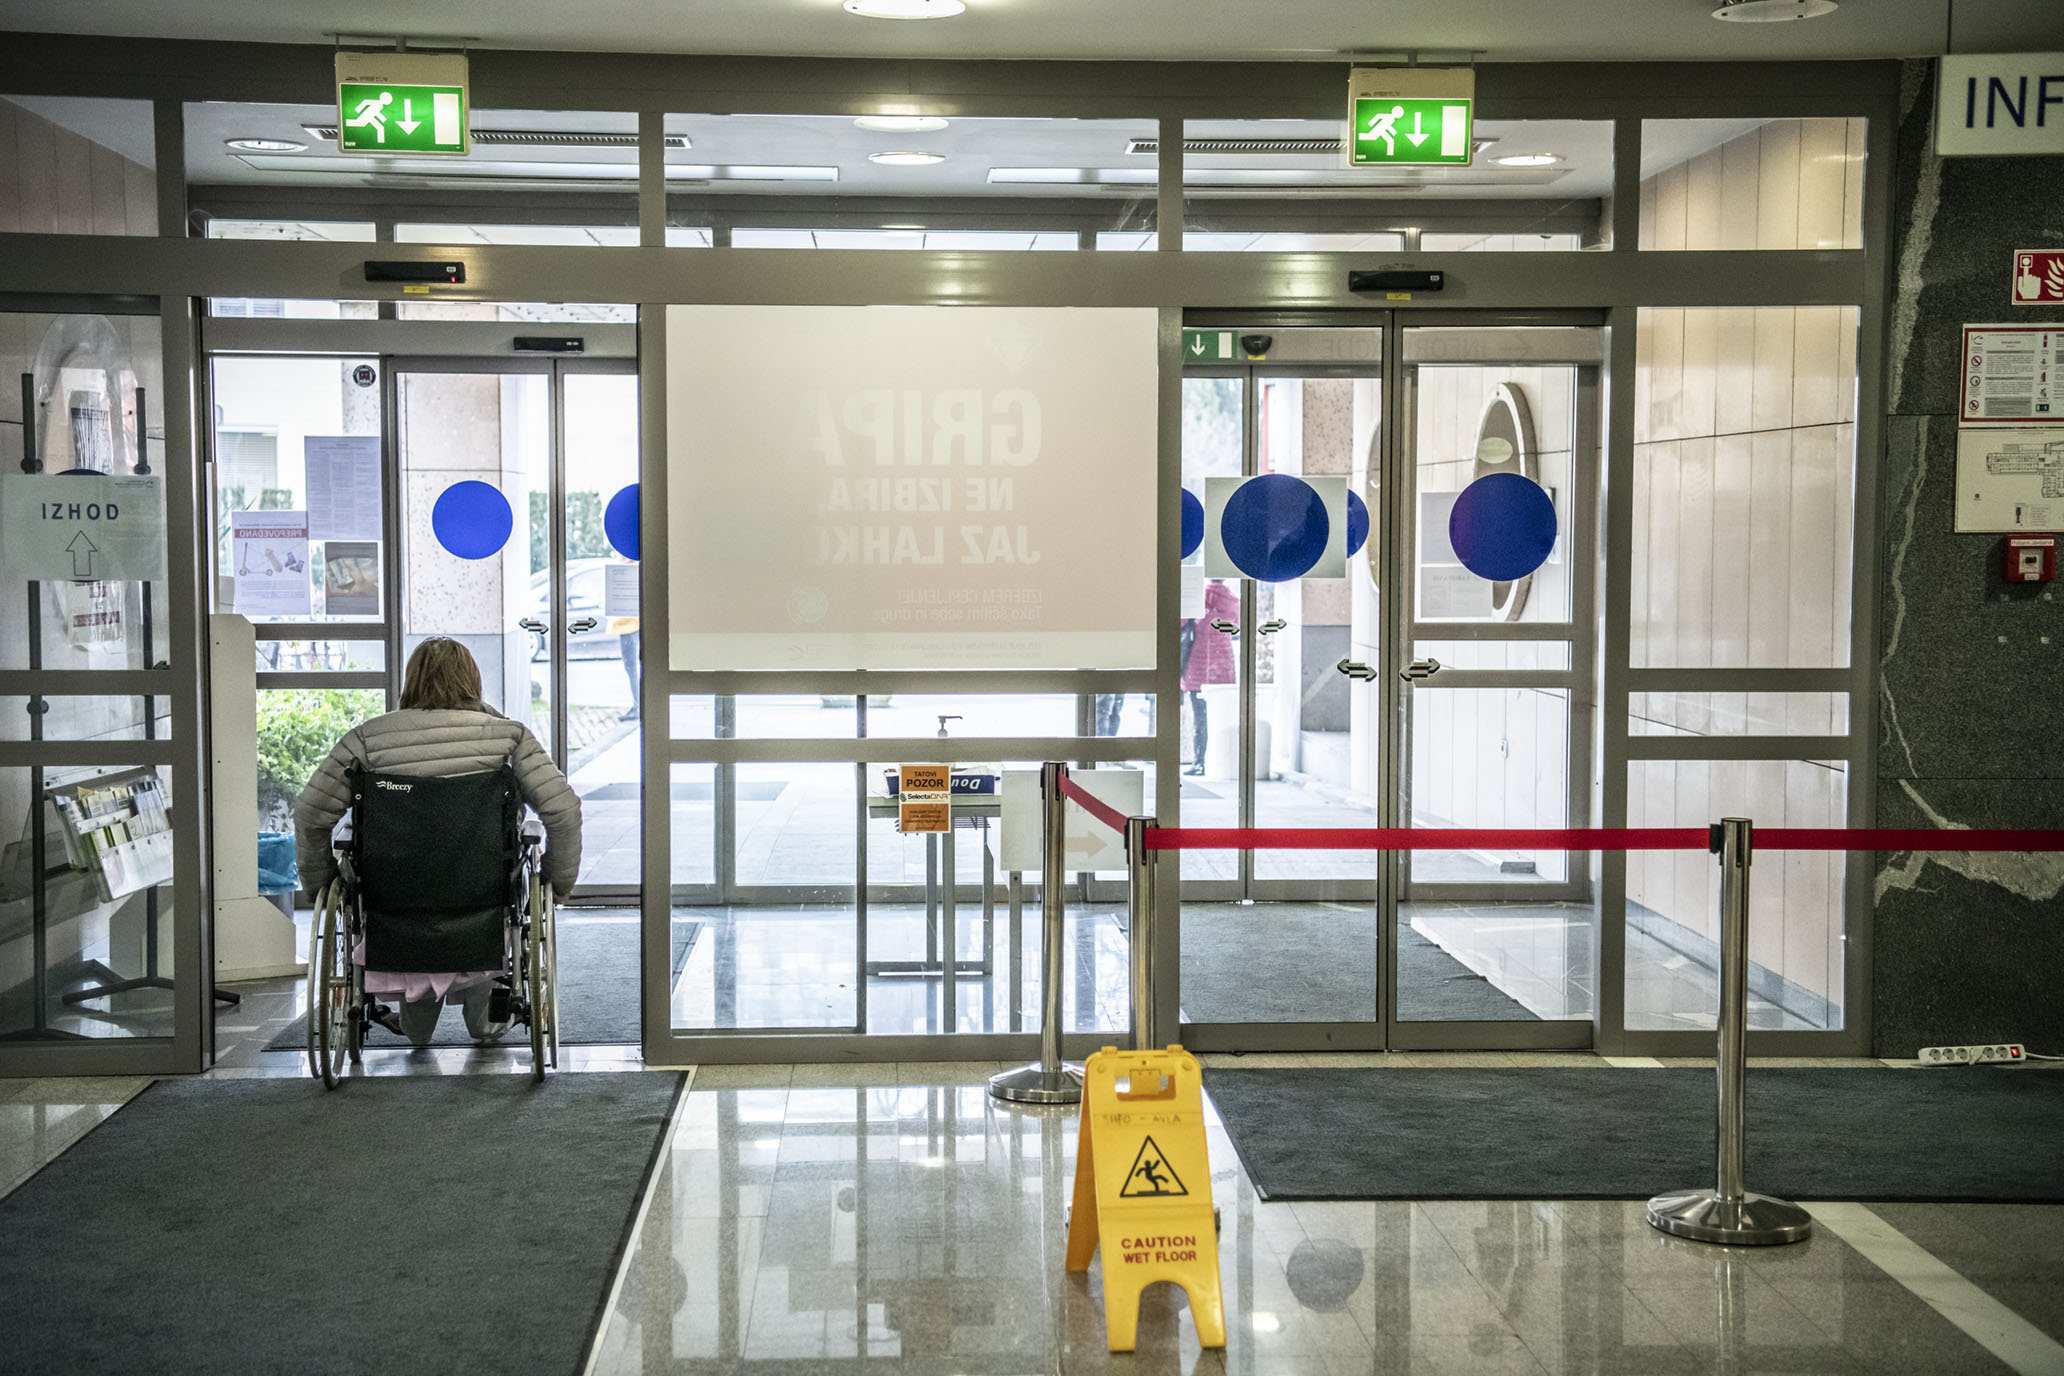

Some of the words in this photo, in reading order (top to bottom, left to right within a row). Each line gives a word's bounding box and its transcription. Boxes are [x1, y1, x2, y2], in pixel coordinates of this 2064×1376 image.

[1965, 76, 2064, 128] INF
[42, 503, 120, 520] IZHOD
[386, 781, 413, 793] Breezy
[907, 779, 944, 788] POZOR
[1121, 1235, 1197, 1250] CAUTION
[1123, 1251, 1150, 1264] WET
[1156, 1250, 1198, 1263] FLOOR
